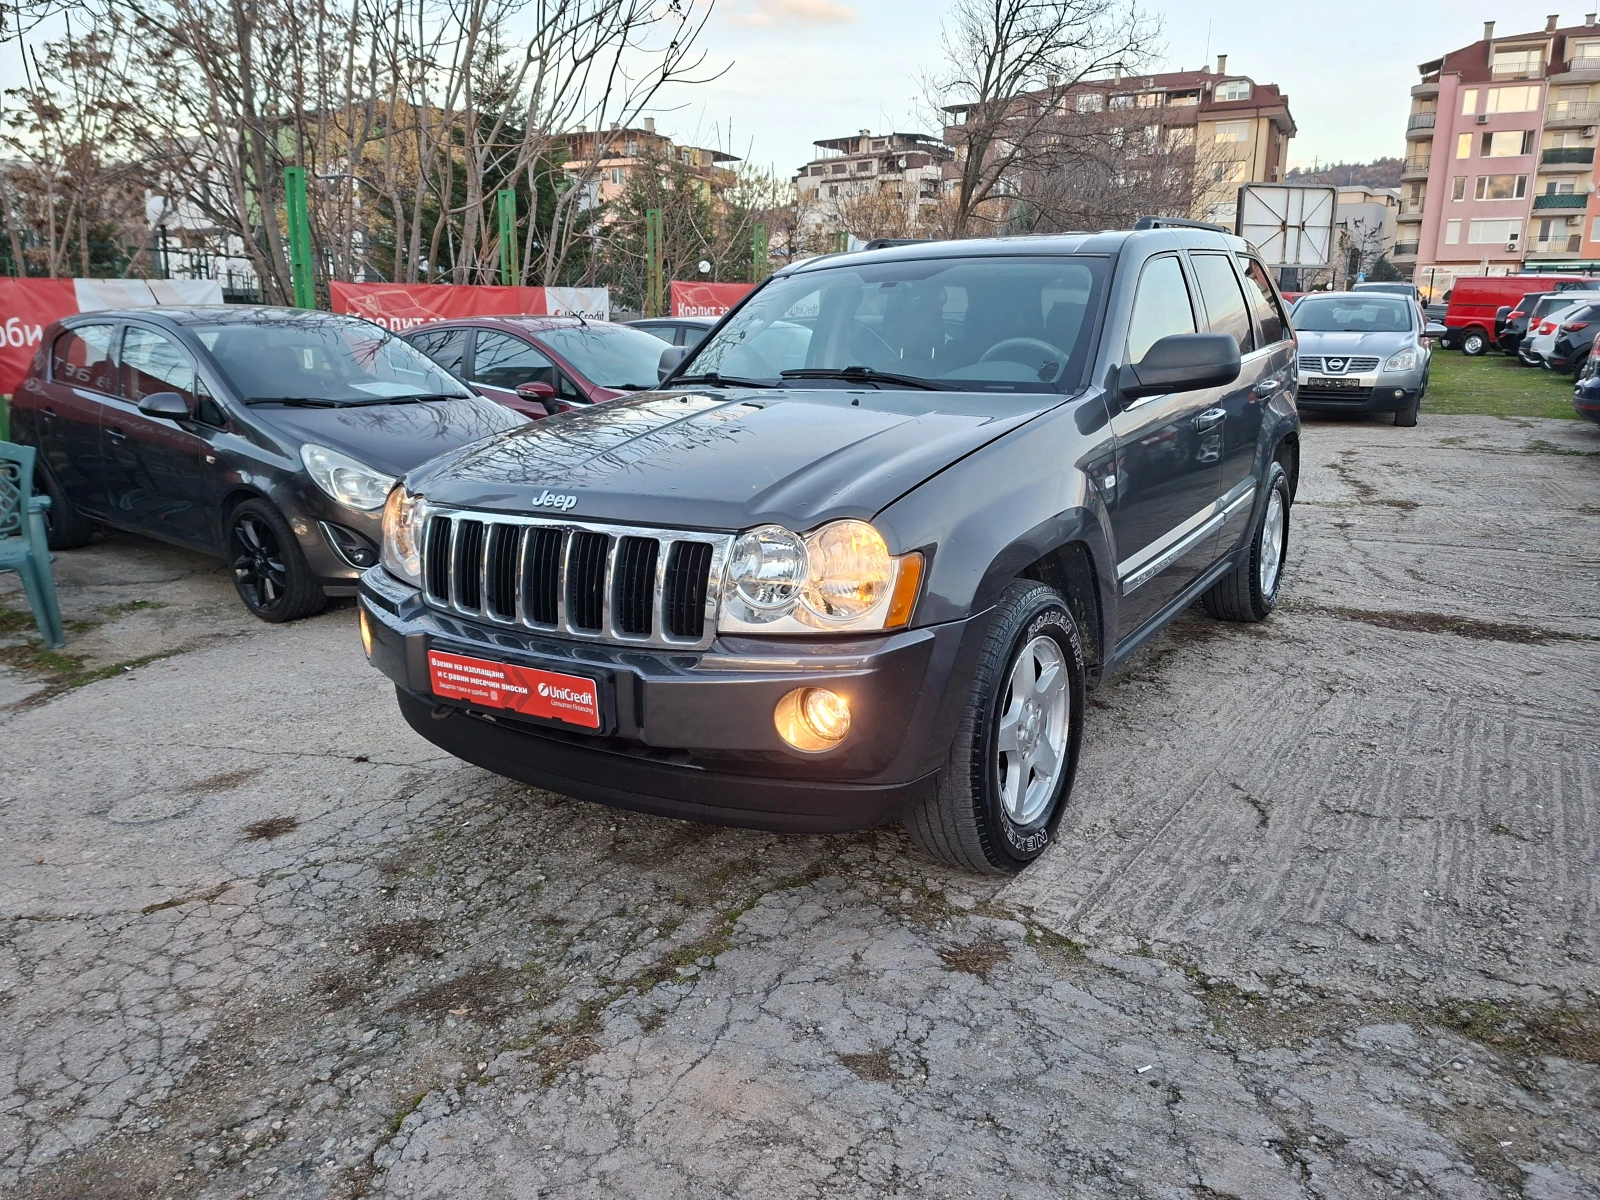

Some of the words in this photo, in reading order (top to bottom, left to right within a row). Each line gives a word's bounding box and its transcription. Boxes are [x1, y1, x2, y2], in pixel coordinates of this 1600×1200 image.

[564, 310, 604, 320] UCredit
[532, 490, 577, 511] Jeep
[431, 658, 453, 669] Вземи
[454, 663, 463, 671] на
[464, 665, 504, 679] изплащане
[448, 673, 469, 683] равни
[470, 677, 500, 689] месечни
[501, 684, 528, 694] вноски
[550, 686, 593, 705] UniCredit
[573, 704, 593, 715] Financing
[1000, 809, 1048, 852] NEXEN
